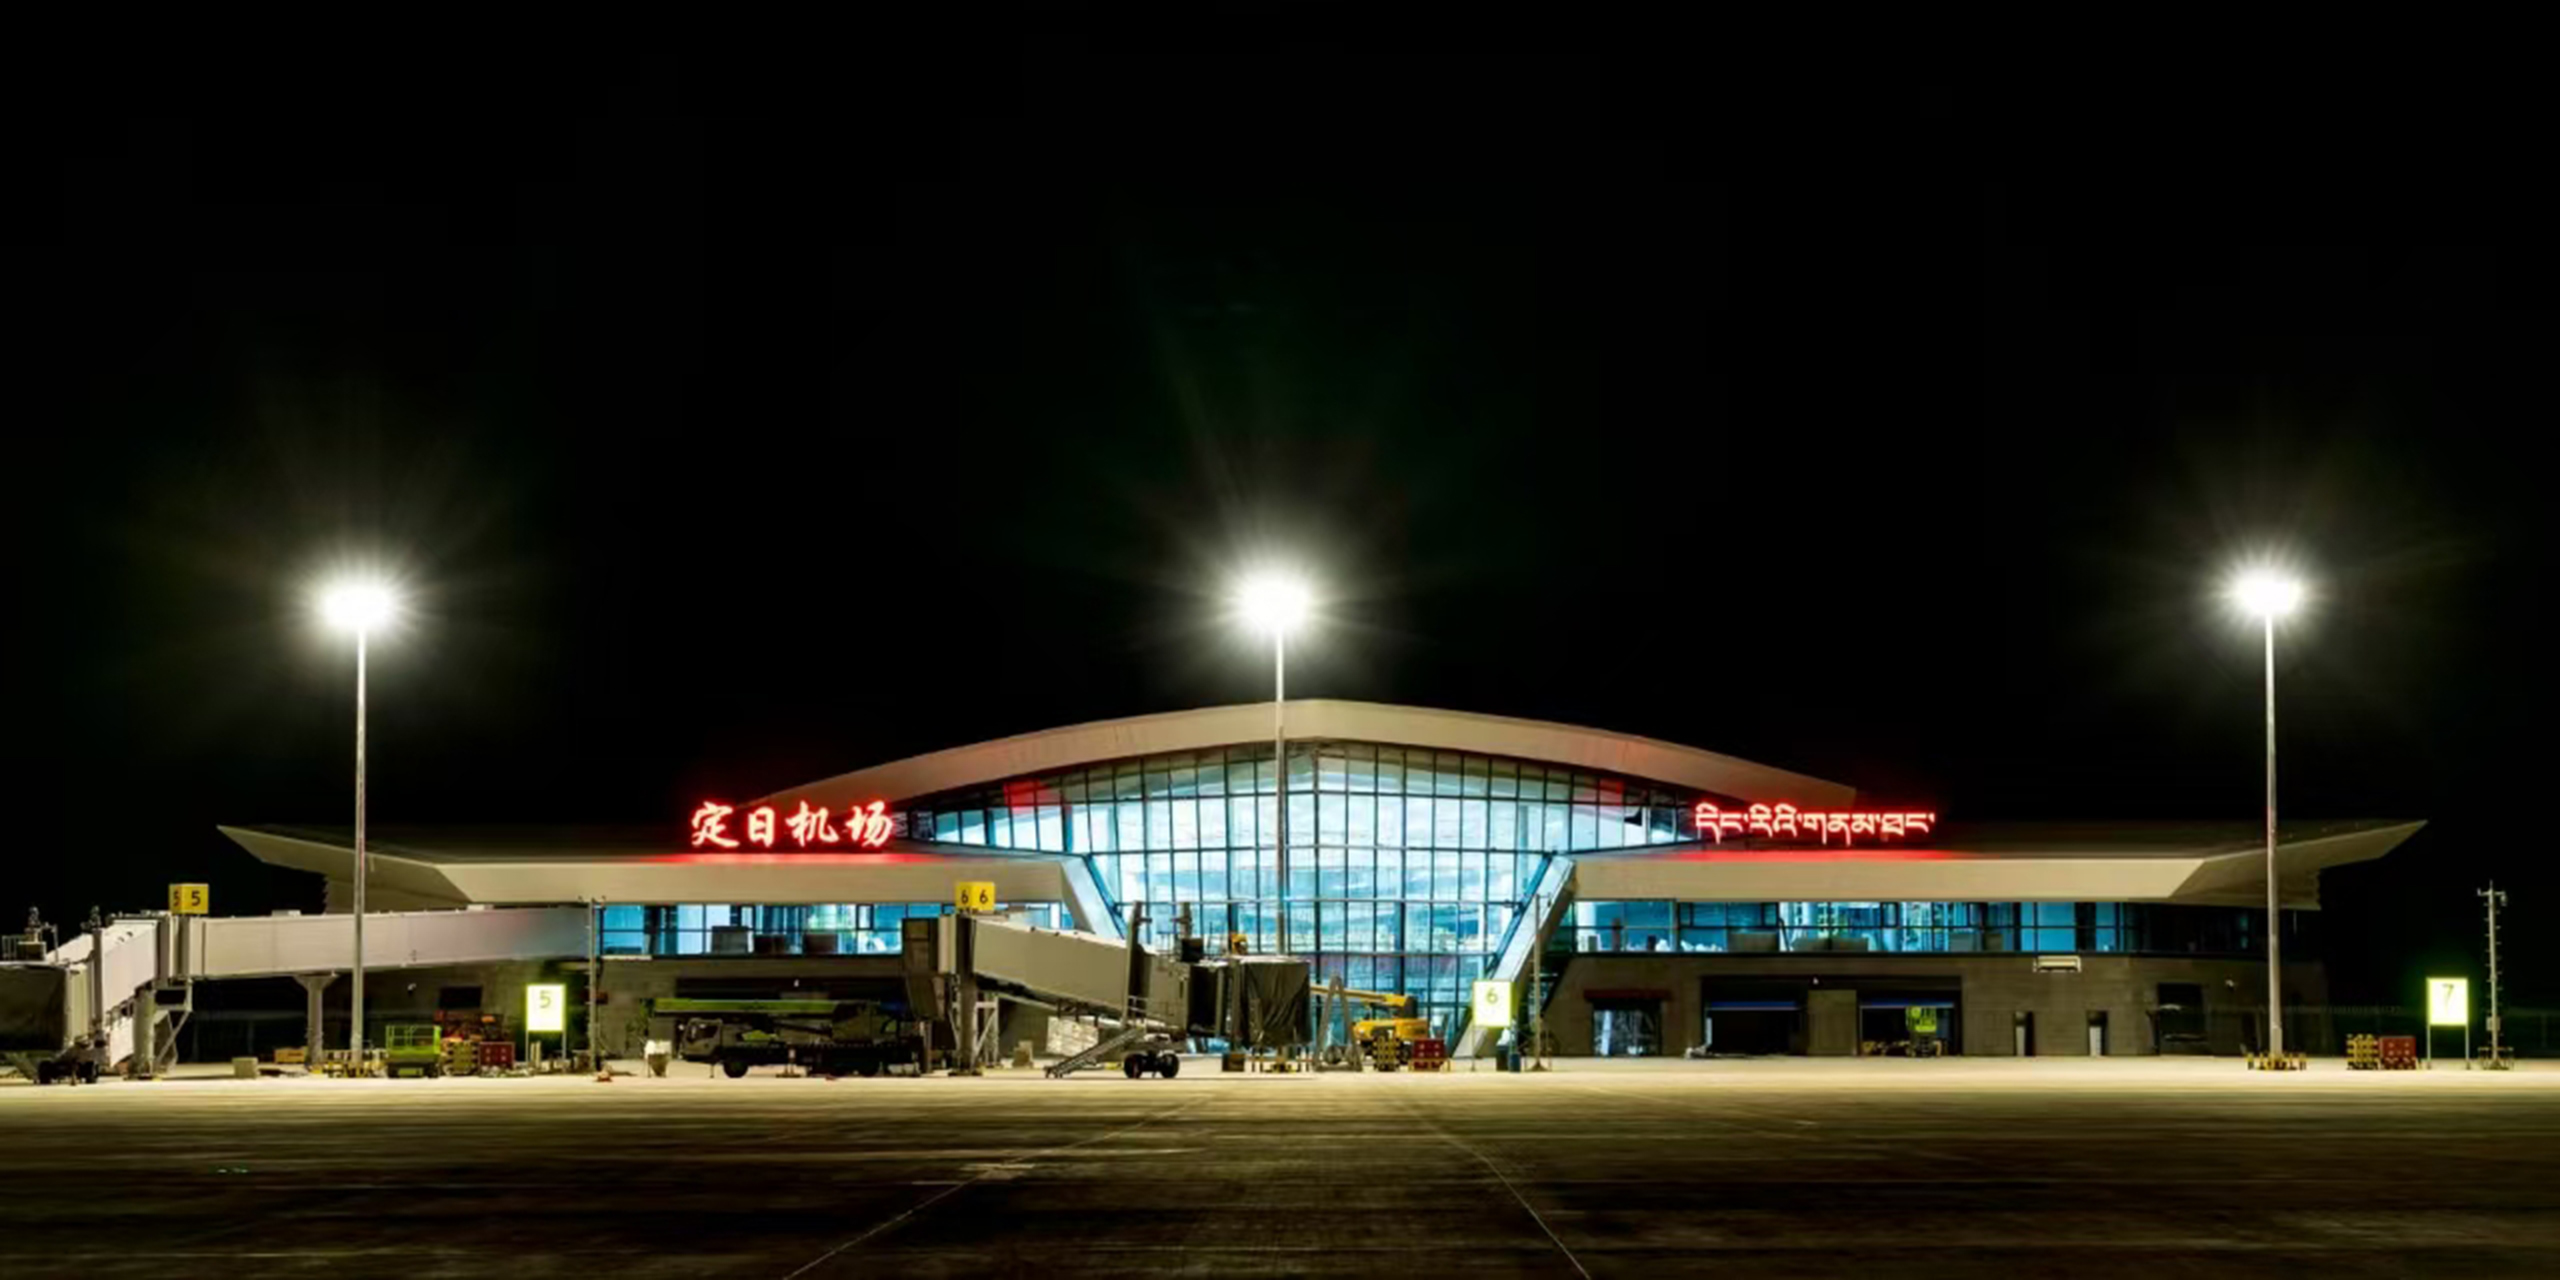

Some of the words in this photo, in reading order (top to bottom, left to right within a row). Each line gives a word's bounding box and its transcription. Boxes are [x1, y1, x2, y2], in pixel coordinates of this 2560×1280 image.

[691, 800, 893, 847] 定日机场
[191, 890, 201, 907] 5
[961, 889, 969, 905] 6
[979, 889, 989, 905] 6
[539, 990, 552, 1009] 5
[1486, 987, 1499, 1005] 6
[2441, 983, 2455, 1007] 7
